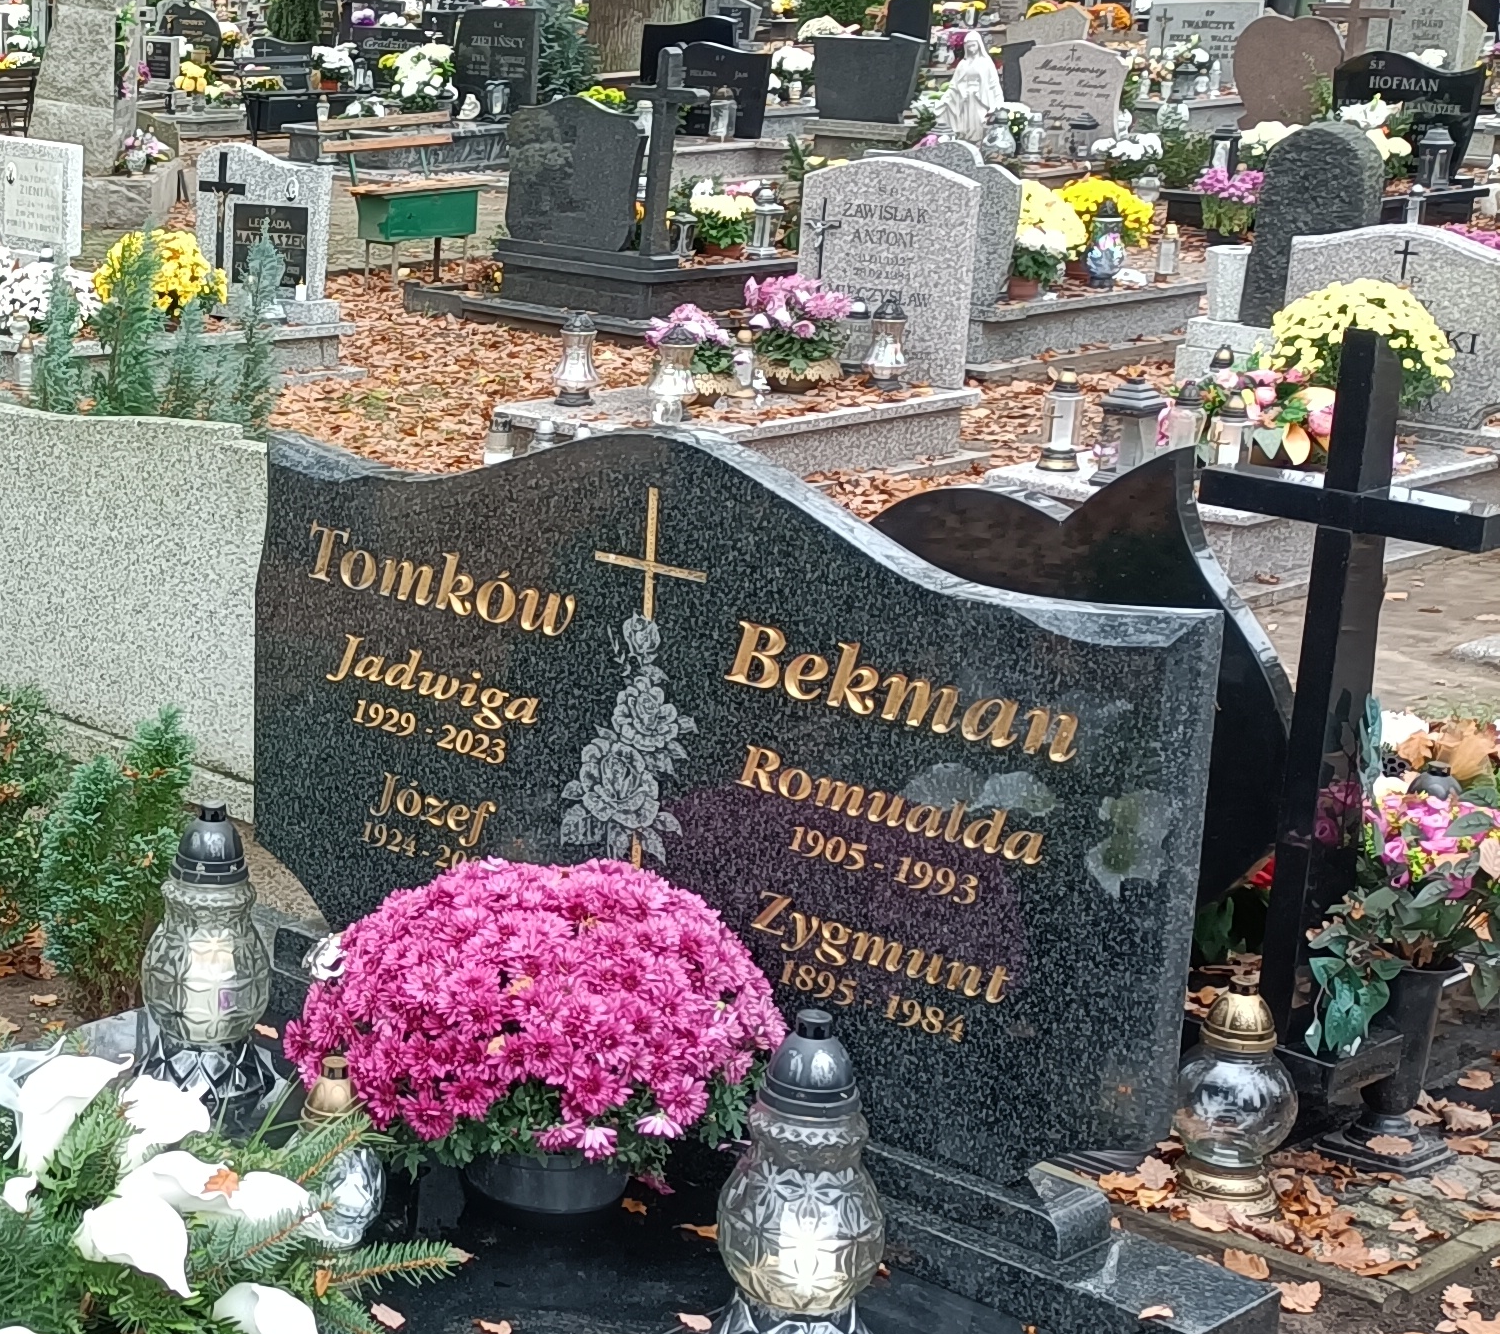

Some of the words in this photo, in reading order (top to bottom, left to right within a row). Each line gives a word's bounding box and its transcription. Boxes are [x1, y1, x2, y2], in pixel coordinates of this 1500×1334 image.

[1368, 75, 1440, 92] HOFMAN
[850, 228, 915, 249] ANTONI
[308, 519, 576, 637] Tomków
[326, 634, 540, 729] Jadwiga
[724, 620, 1079, 763] Bekman
[353, 699, 416, 737] 1929
[436, 724, 507, 764] 2023
[361, 821, 416, 858] 1924
[369, 771, 497, 847] Józef
[734, 744, 1045, 865] Romualda
[788, 826, 868, 870] 1905
[893, 856, 979, 905] 1993
[750, 890, 1011, 1004] Zygmunt
[779, 959, 858, 1006] 1895
[884, 994, 965, 1043] 1984
